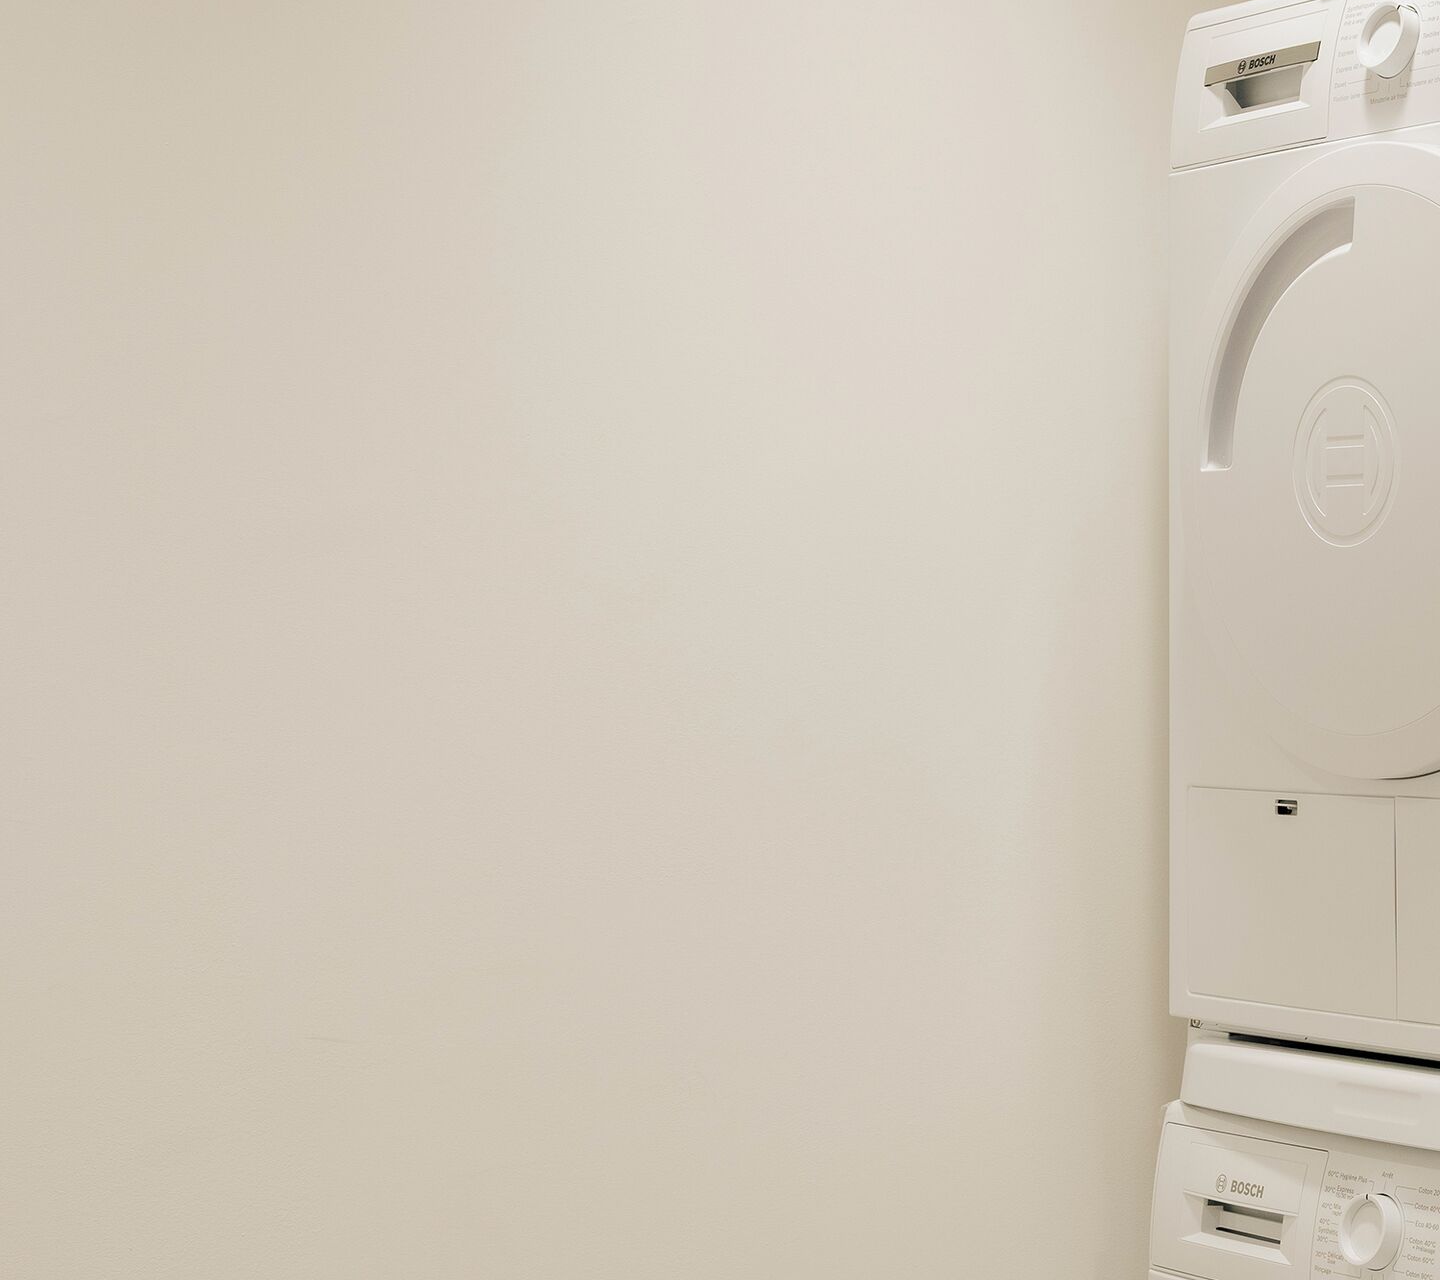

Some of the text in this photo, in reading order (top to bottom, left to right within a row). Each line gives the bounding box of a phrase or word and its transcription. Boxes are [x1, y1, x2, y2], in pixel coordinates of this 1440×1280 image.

[1248, 54, 1277, 69] BOSCH
[1328, 1170, 1339, 1178] 60°C
[1230, 1180, 1265, 1199] BOSCH
[1337, 1186, 1354, 1194] Express
[1419, 1187, 1433, 1195] Coton
[1415, 1203, 1429, 1211] Coton
[1409, 1237, 1436, 1248] Coton 40°C
[1407, 1254, 1421, 1262] Coton
[1406, 1270, 1420, 1278] Coton
